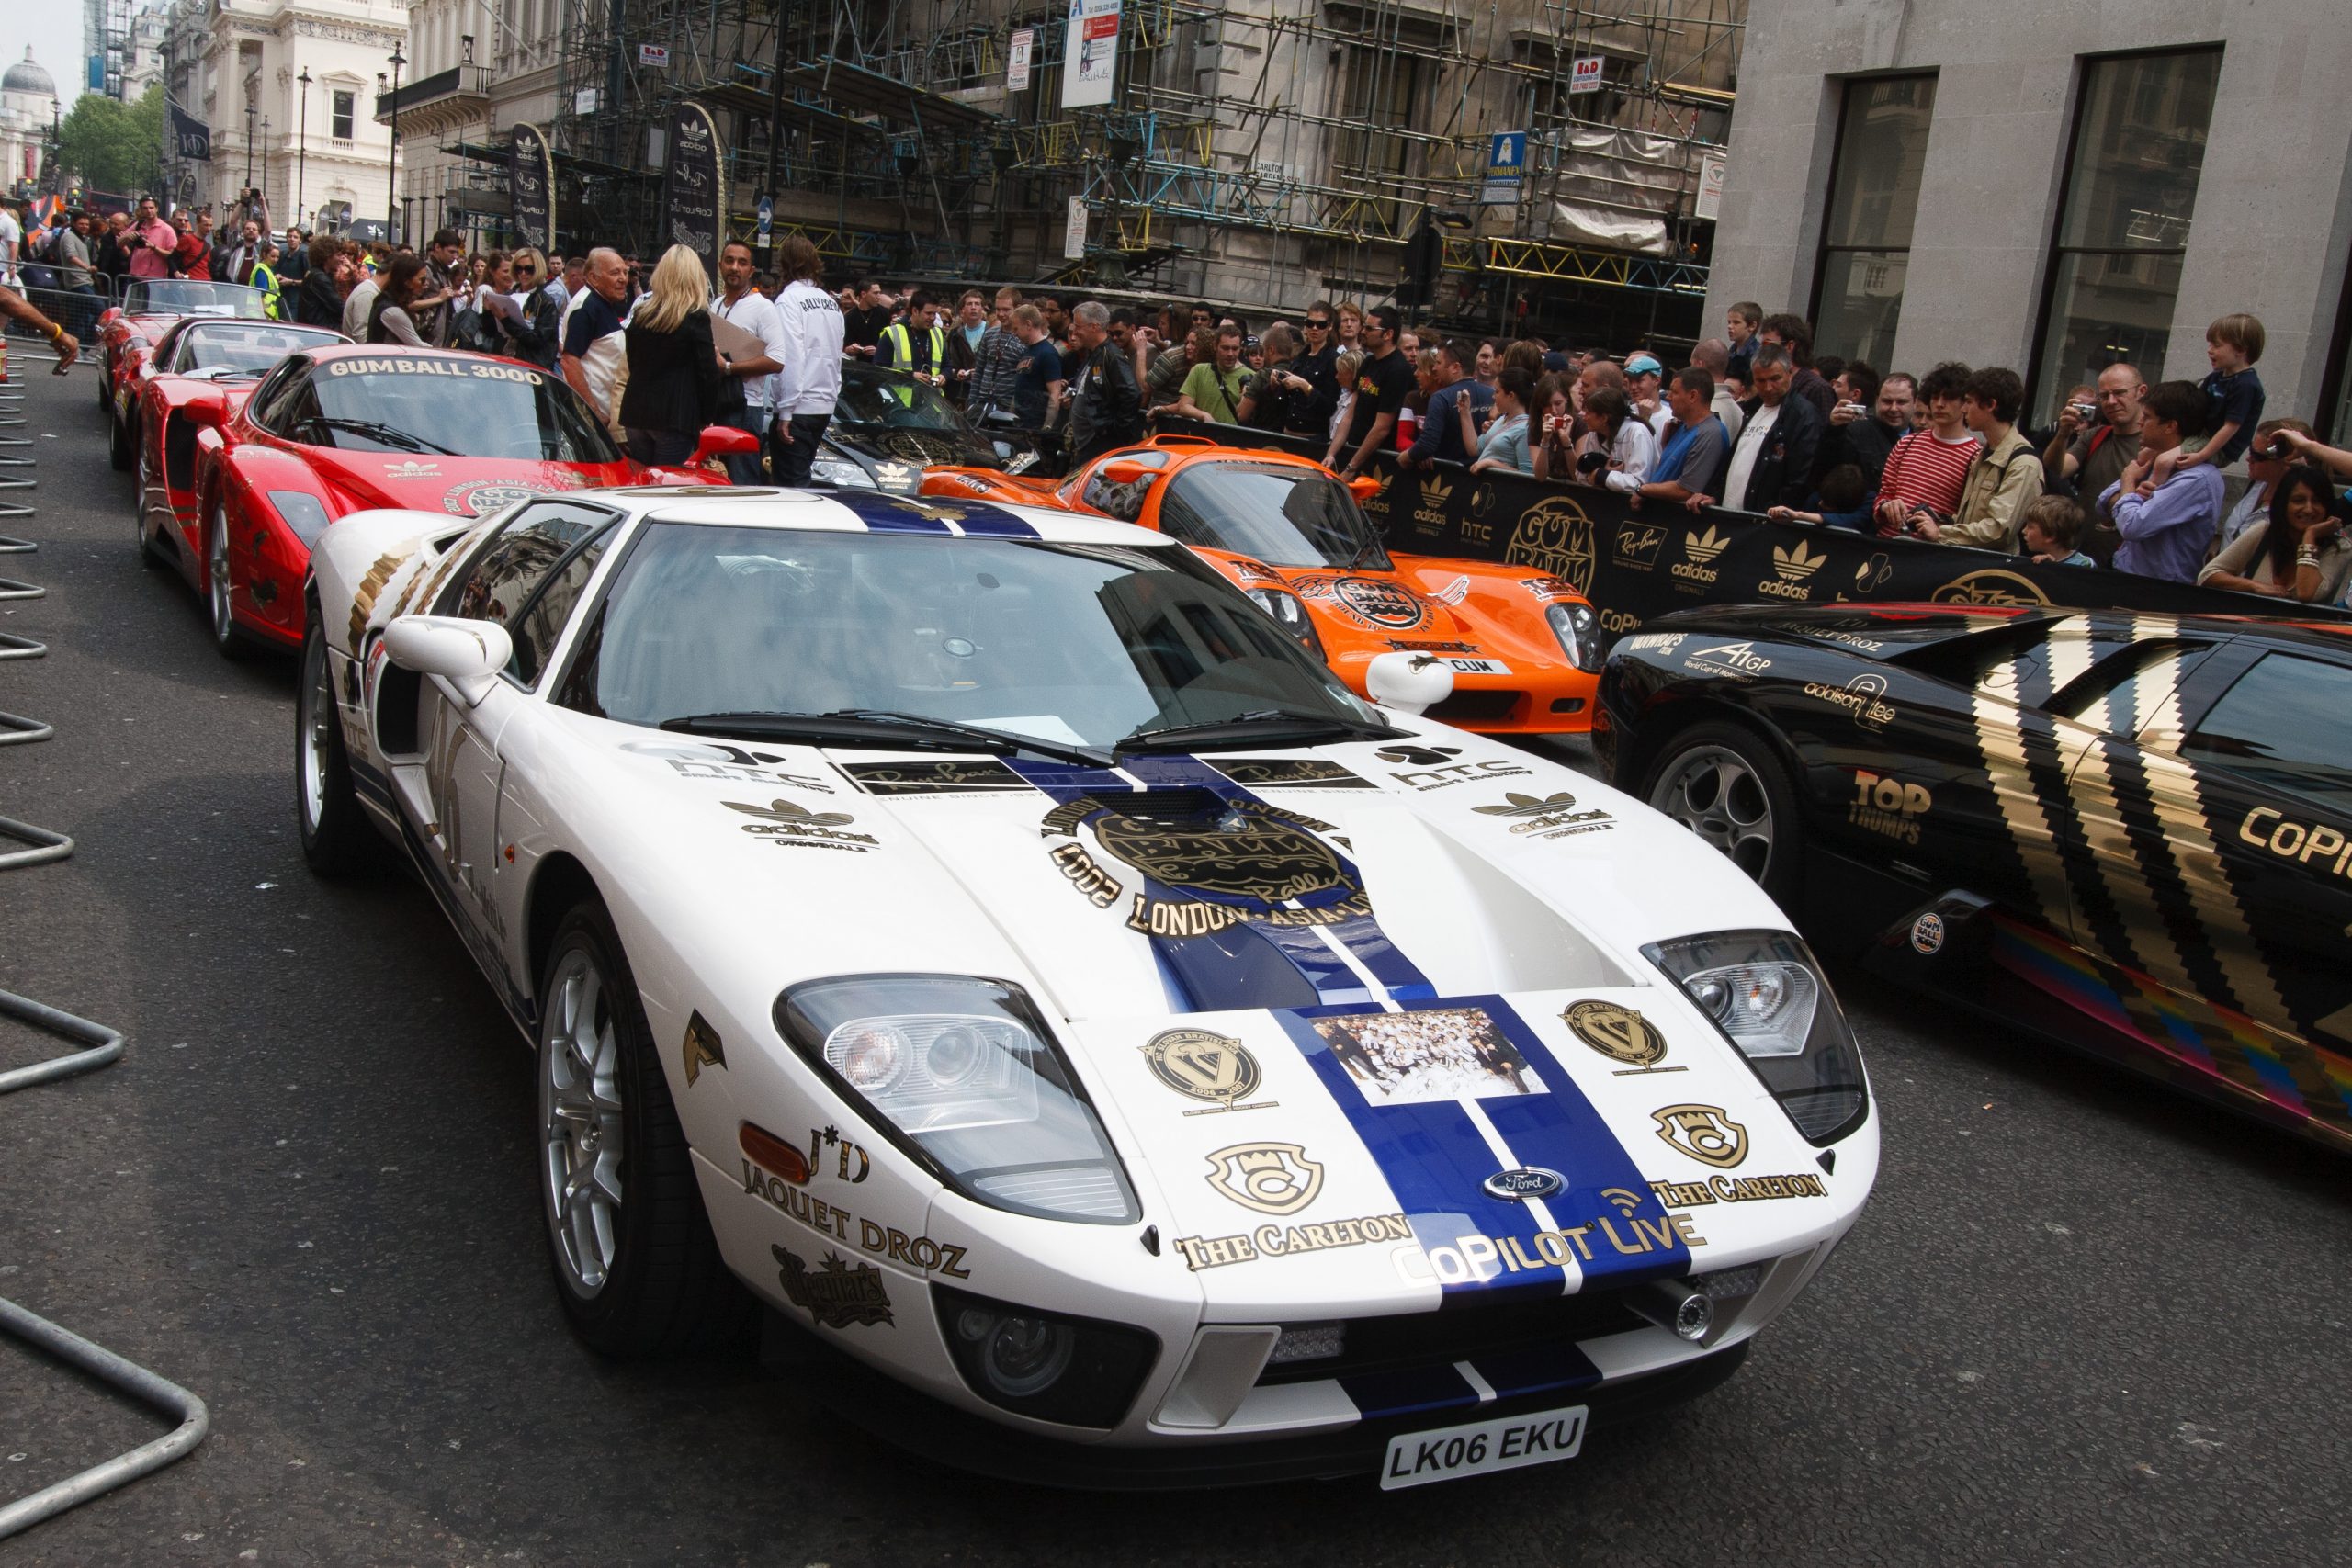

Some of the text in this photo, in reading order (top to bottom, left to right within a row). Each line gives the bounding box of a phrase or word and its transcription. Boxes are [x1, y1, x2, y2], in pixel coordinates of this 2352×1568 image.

[799, 297, 820, 312] RALLY
[330, 359, 543, 385] GUMBALL 3000
[386, 469, 443, 479] adidas
[1413, 509, 1447, 526] adidas
[1618, 528, 1661, 557] Ray-Ban
[1670, 562, 1718, 582] adidas
[1758, 580, 1810, 601] adidas
[1838, 634, 1883, 652] DROZ
[1451, 660, 1494, 672] CUM
[1684, 660, 1701, 670] World
[1700, 663, 1713, 674] Cup
[1804, 682, 1864, 711] addison
[1416, 768, 1534, 793] smart mobility
[1854, 769, 1932, 819] TOP
[1508, 808, 1613, 835] adidas
[1848, 800, 1922, 846] TRUMPS
[741, 823, 880, 845] adidas
[1129, 896, 1250, 936] LONDON
[1270, 908, 1344, 926] ASIA
[1920, 919, 1941, 932] GUM
[1917, 926, 1939, 941] BALL
[1505, 1172, 1544, 1191] Ford
[741, 1158, 971, 1280] JAQUET DROZ
[1388, 1416, 1581, 1478] LK06 EKU
